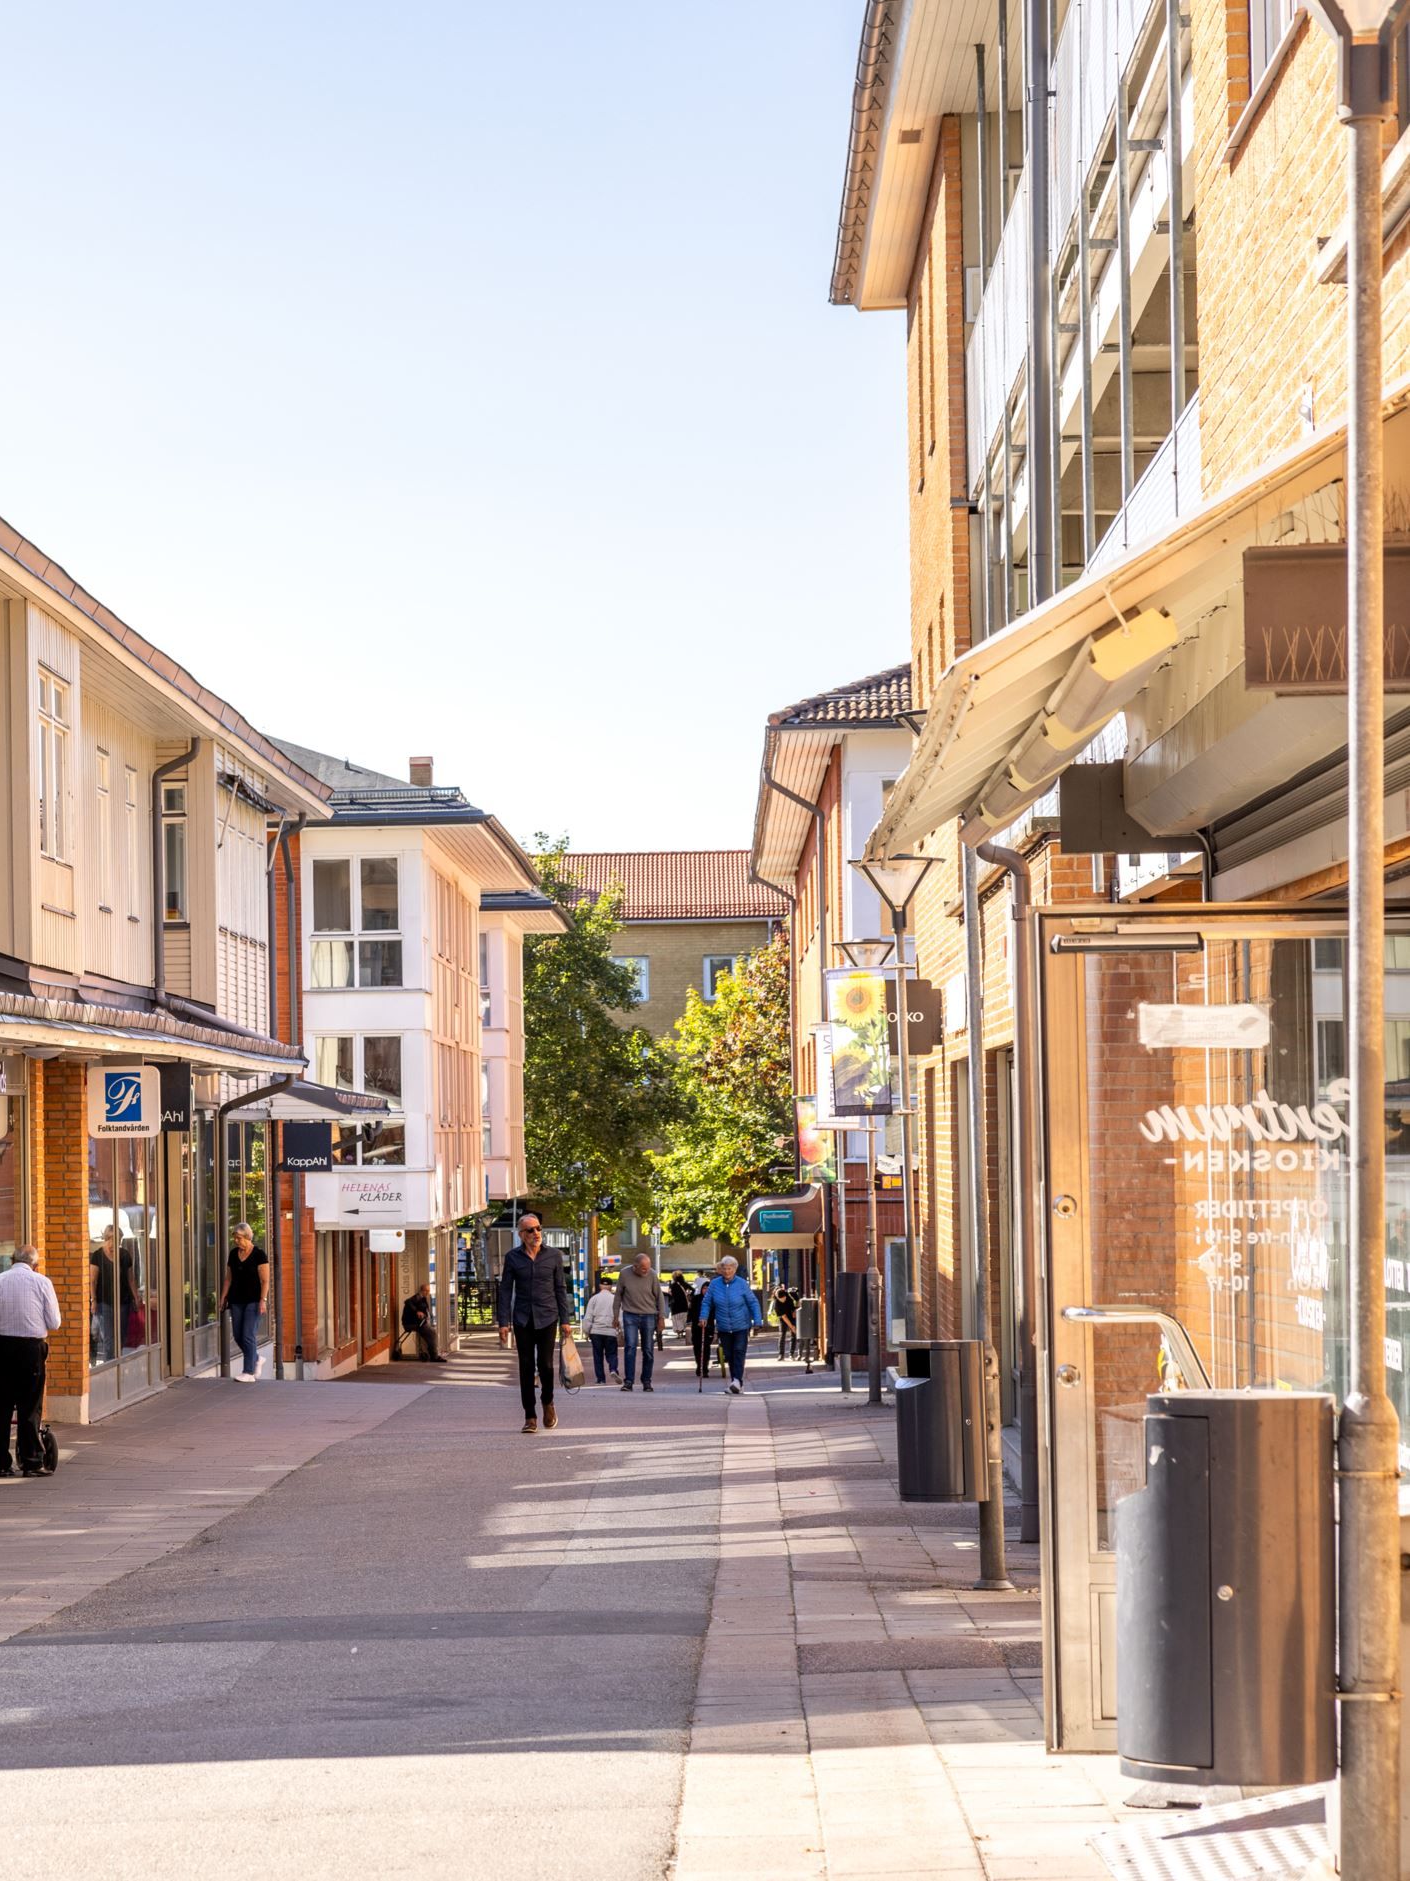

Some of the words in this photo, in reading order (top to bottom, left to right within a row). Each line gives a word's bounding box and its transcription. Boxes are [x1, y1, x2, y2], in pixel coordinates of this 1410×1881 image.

[97, 1124, 150, 1133] Folktandvården
[287, 1156, 328, 1168] KappAhl
[341, 1182, 392, 1193] HELENAS
[359, 1191, 403, 1202] KLÄDER
